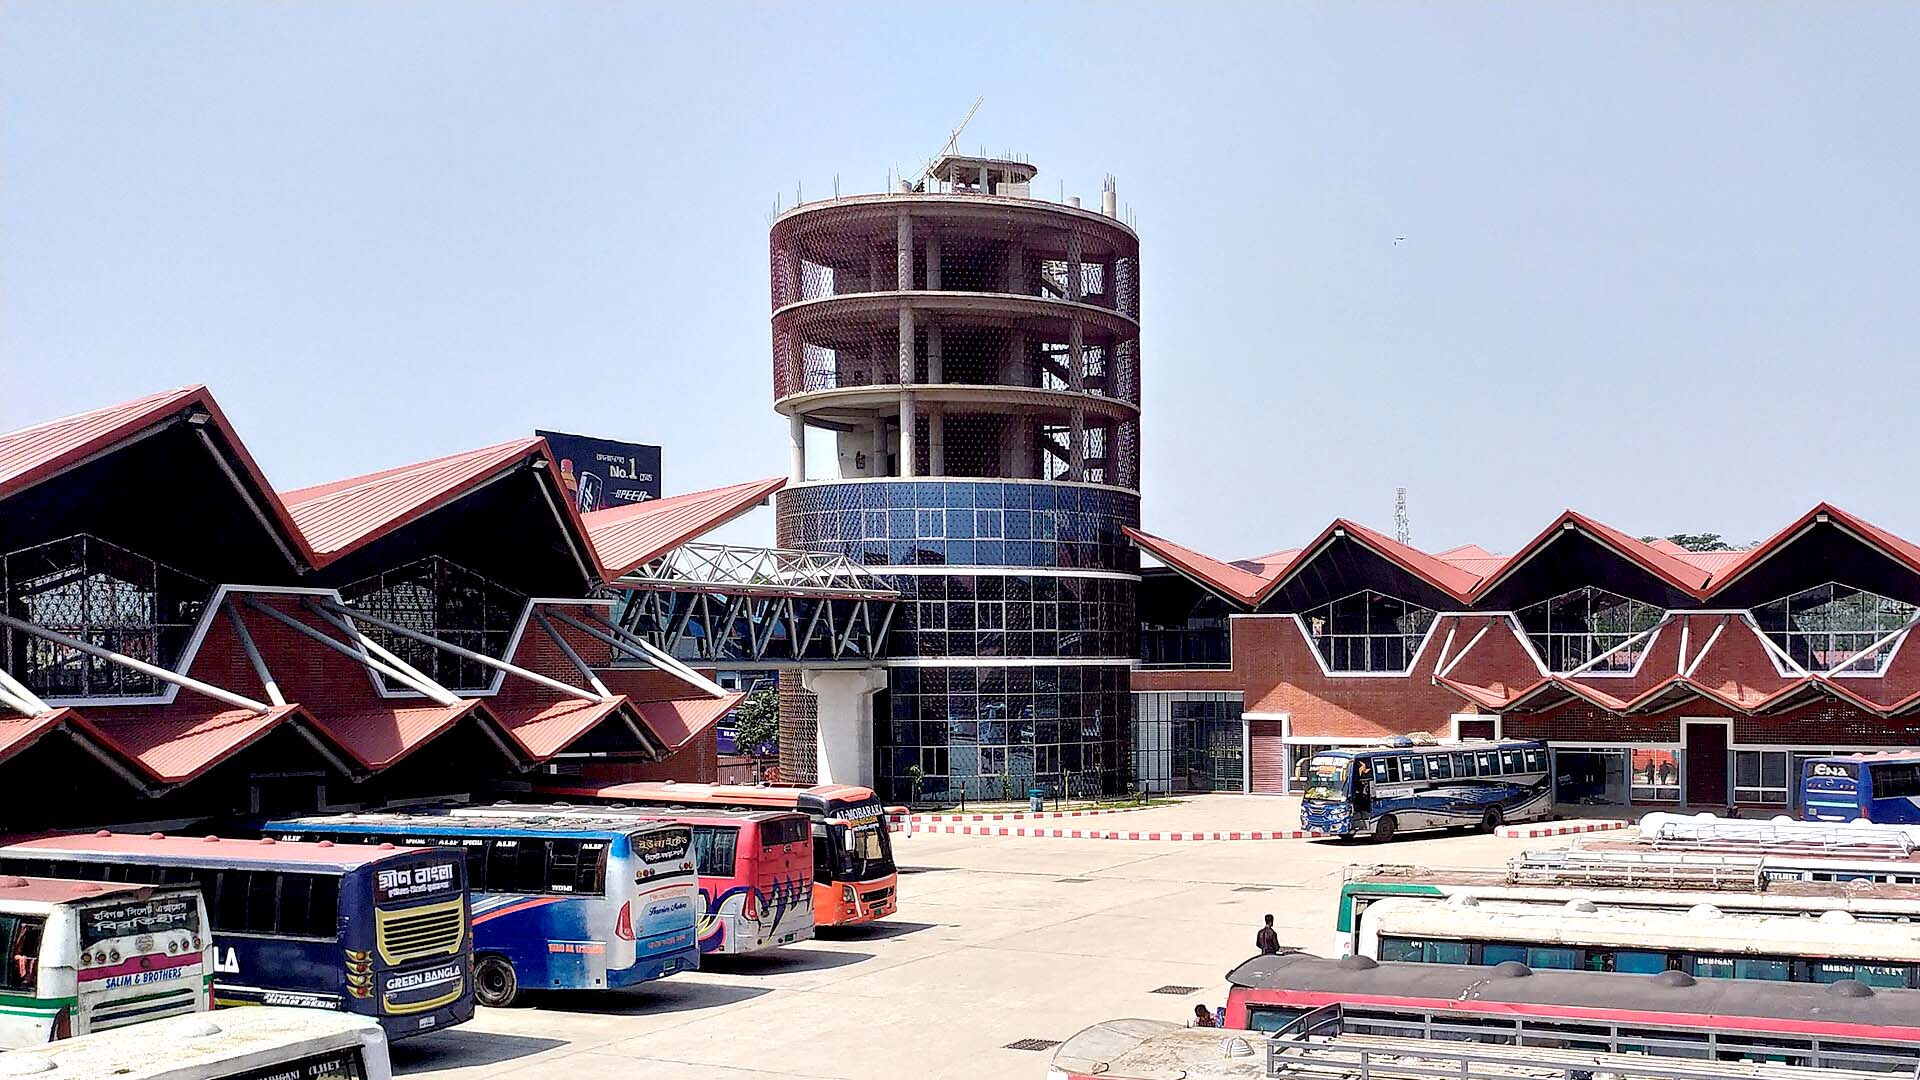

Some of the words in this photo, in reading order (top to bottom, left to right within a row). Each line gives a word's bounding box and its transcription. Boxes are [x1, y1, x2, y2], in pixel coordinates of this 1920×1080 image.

[106, 975, 133, 989] SALIM
[134, 974, 141, 984] &
[143, 967, 182, 983] BROTHERS
[386, 973, 423, 990] GREEN
[424, 965, 461, 982] BANGLA
